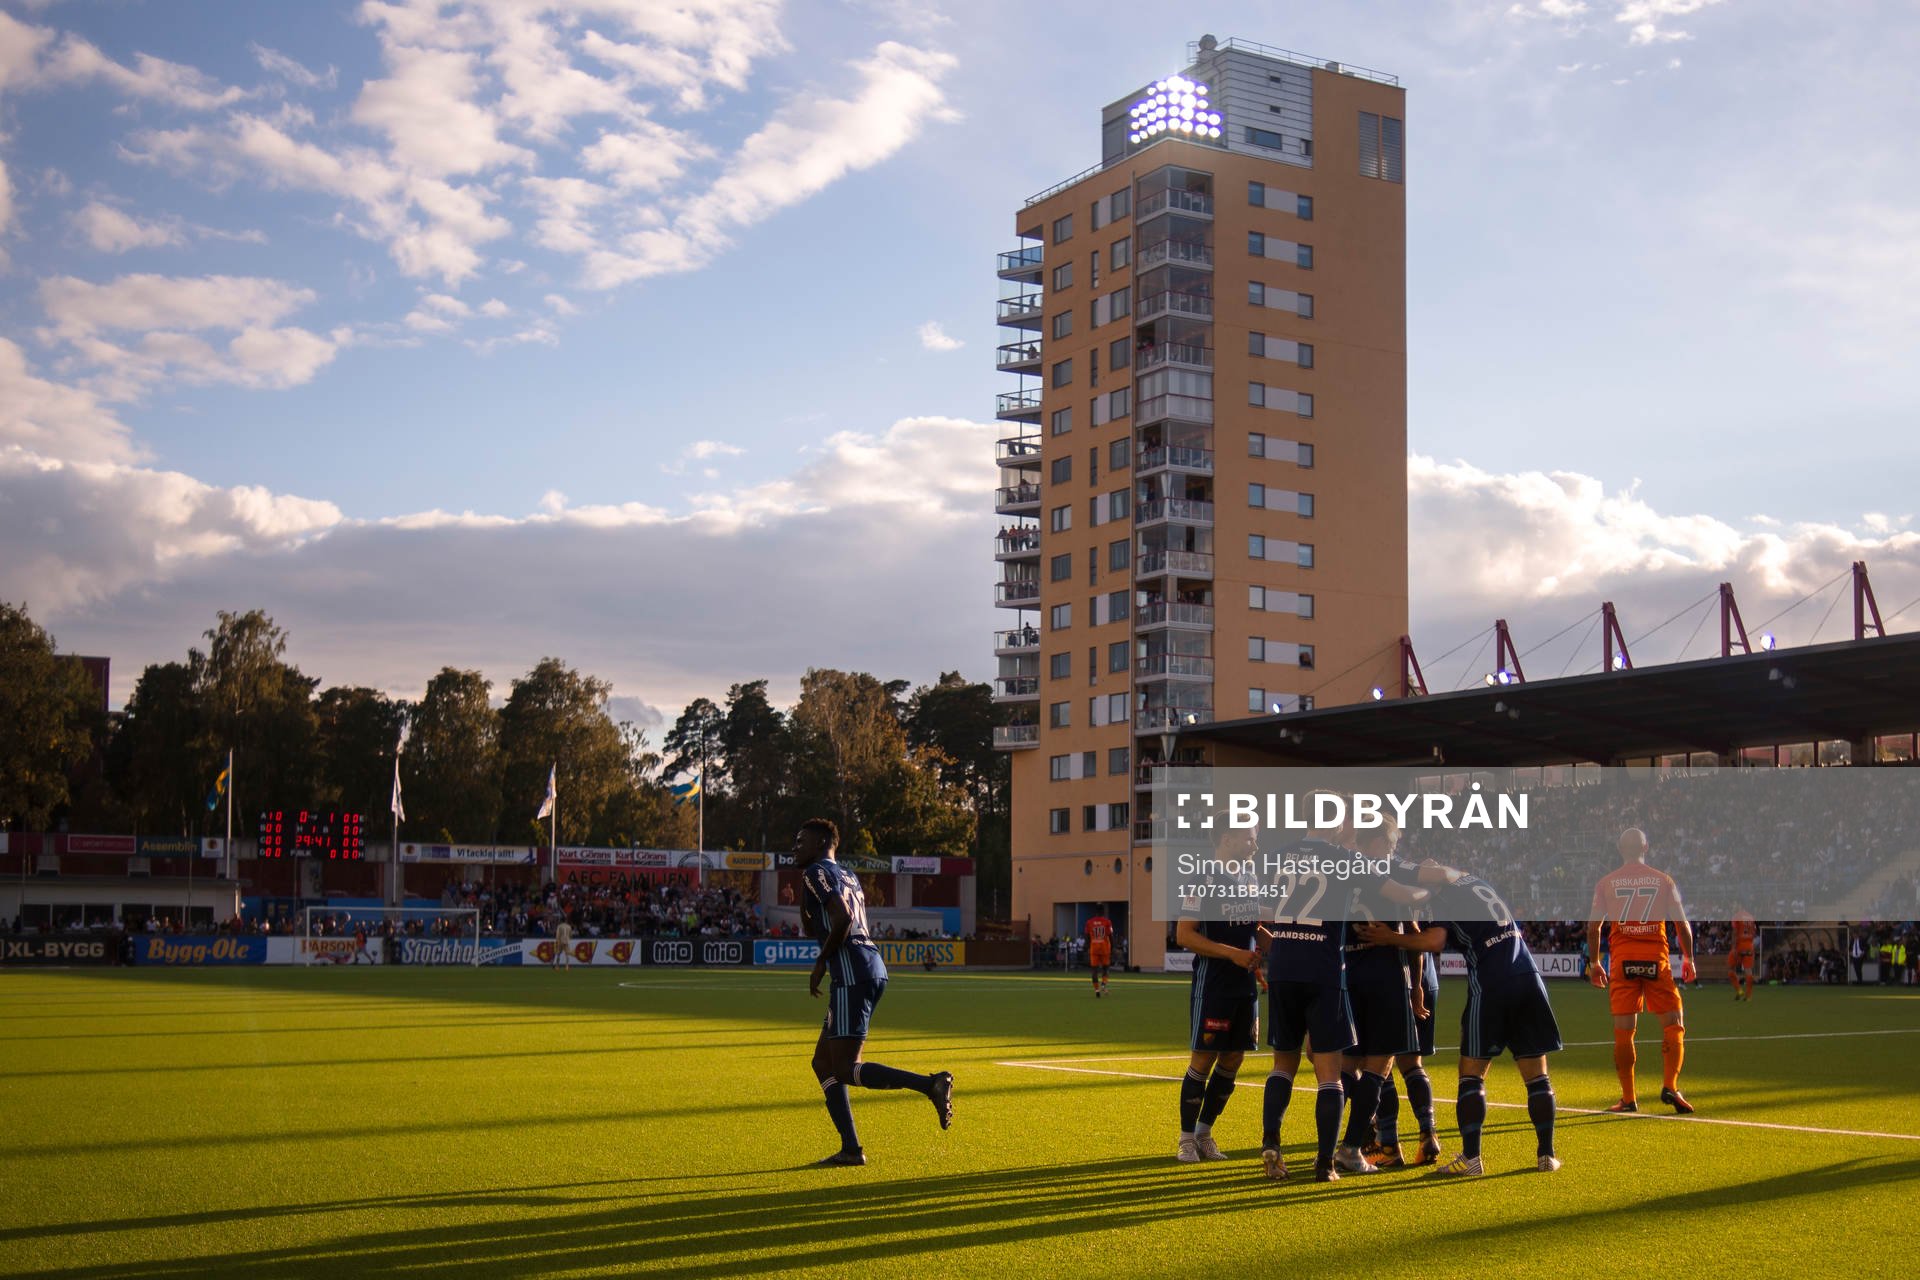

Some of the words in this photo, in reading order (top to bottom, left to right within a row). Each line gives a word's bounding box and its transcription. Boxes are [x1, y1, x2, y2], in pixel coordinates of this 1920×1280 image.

[1610, 876, 1661, 887] TSISKARIDZE
[1273, 868, 1328, 927] 22
[1472, 885, 1512, 927] 8
[1614, 886, 1658, 926] 77
[8, 941, 105, 958] XL-BYGG
[764, 942, 820, 963] ginza
[880, 943, 904, 962] ITY
